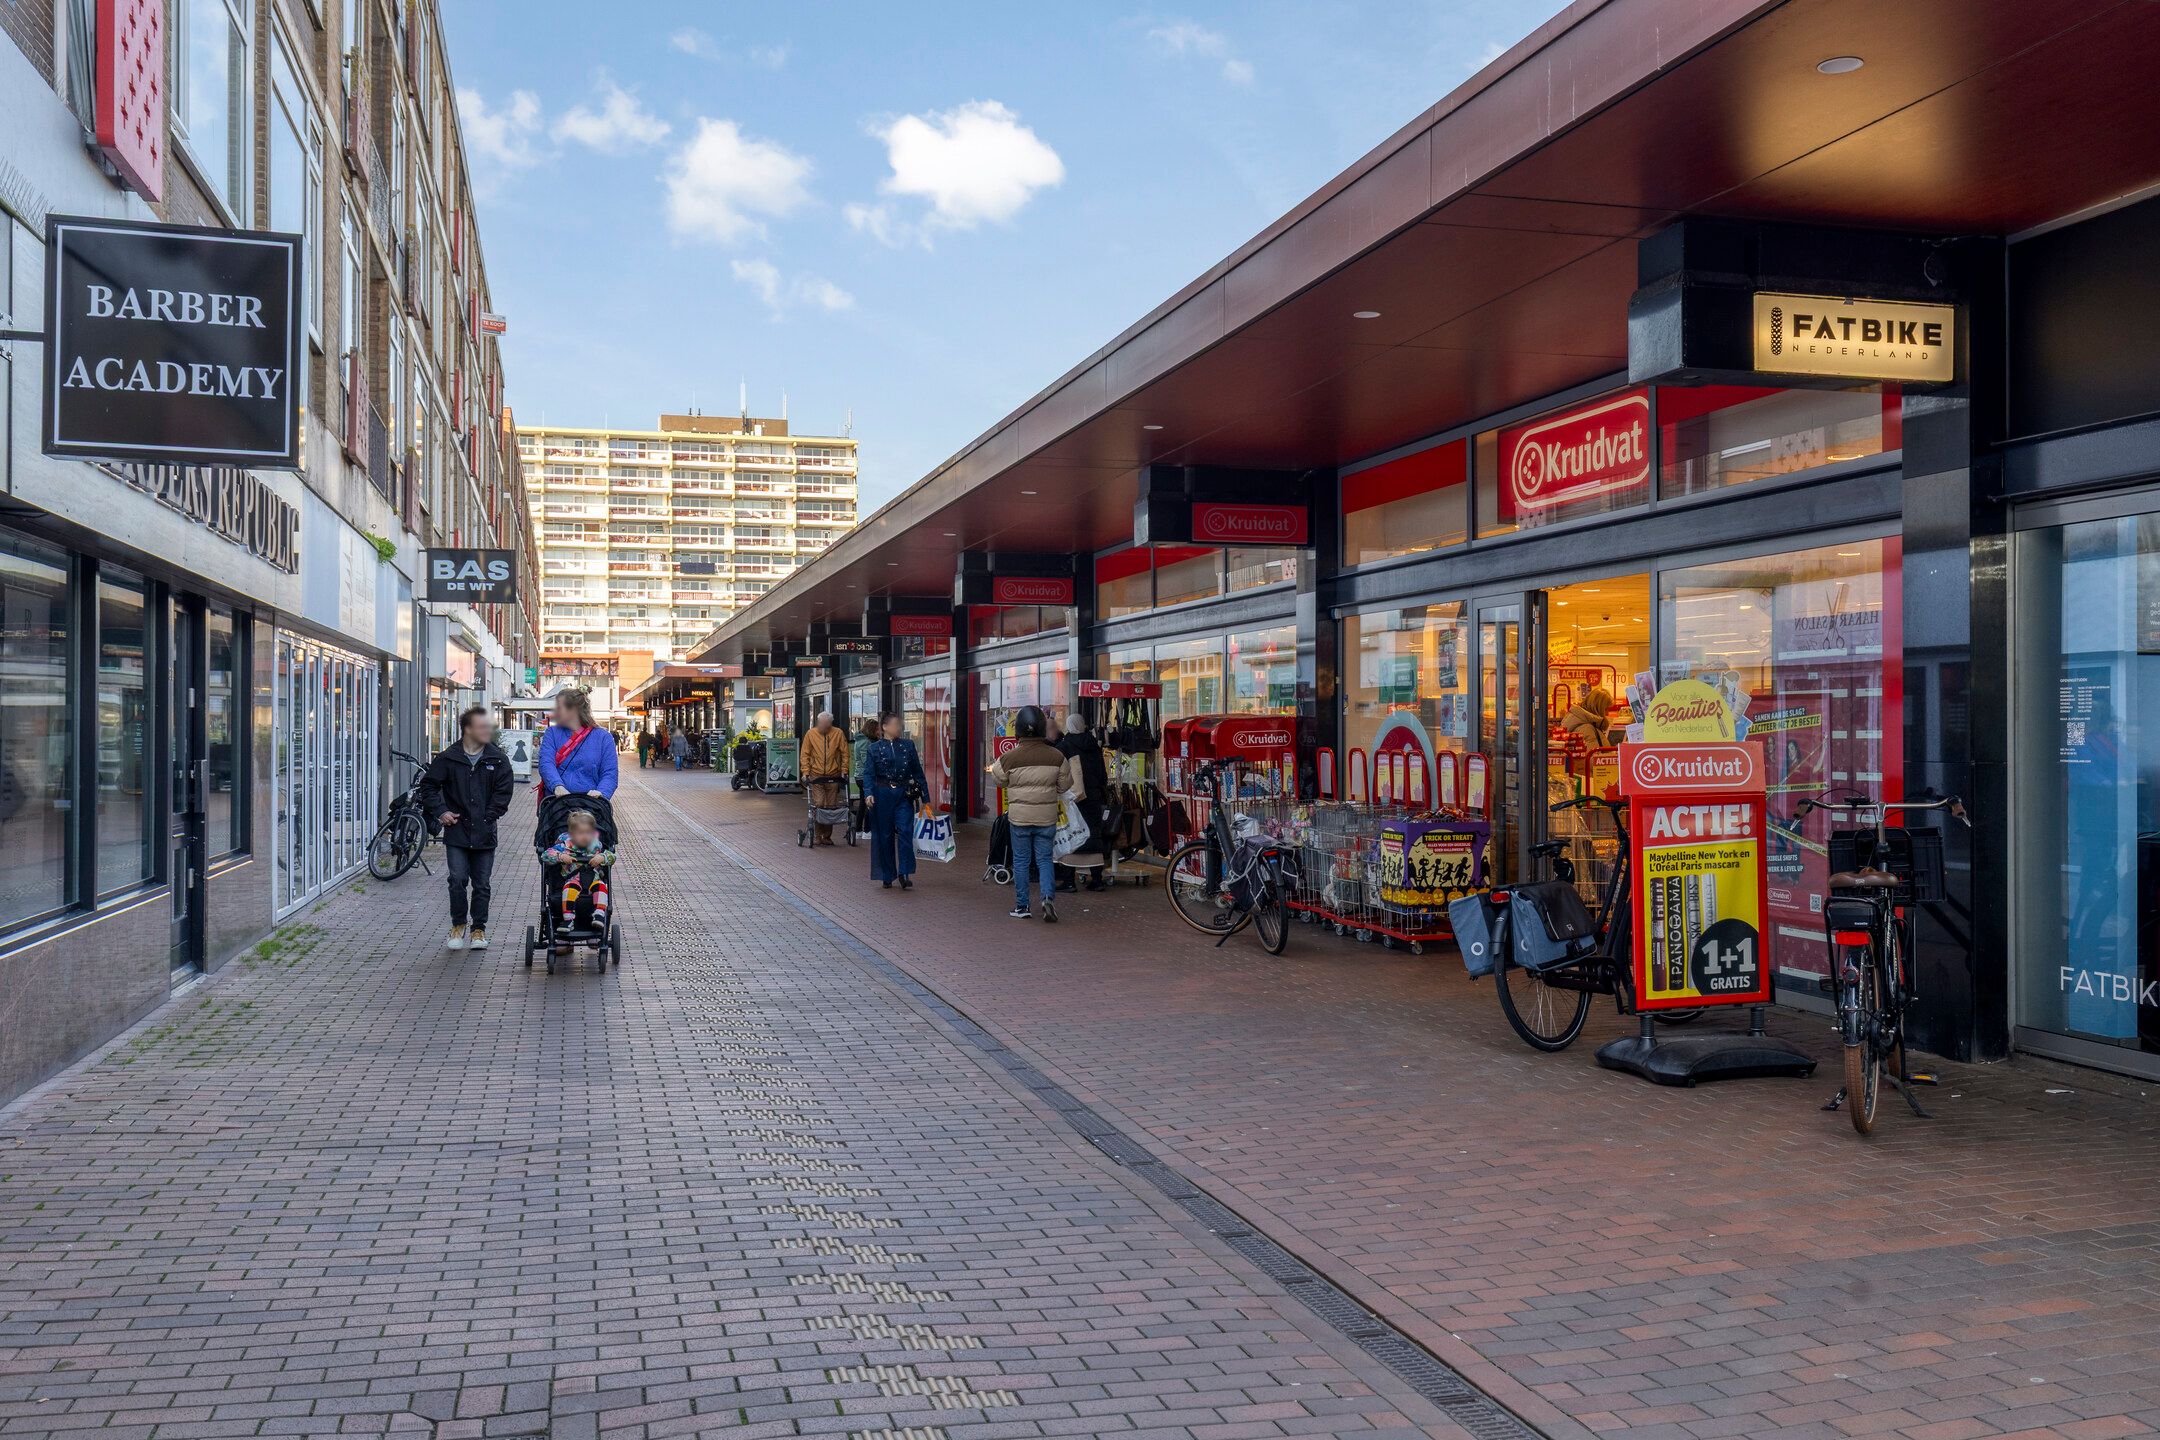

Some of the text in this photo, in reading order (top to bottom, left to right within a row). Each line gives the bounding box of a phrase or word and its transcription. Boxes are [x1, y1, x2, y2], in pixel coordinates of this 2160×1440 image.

[87, 285, 266, 328] BARBER
[1793, 314, 1942, 347] FATBIKE
[1792, 345, 1928, 360] NEDERLAND
[63, 356, 284, 399] ACADEMY
[1546, 420, 1643, 483] Kruidvat
[218, 468, 299, 575] REPUBLIC
[1228, 515, 1289, 531] Kruidvat
[433, 559, 510, 581] BAS
[447, 582, 495, 591] DE WIT
[1017, 585, 1061, 596] Kruidvat
[909, 621, 943, 630] Kruidvat
[1561, 670, 1587, 679] ACTIE!
[1606, 674, 1627, 684] FOTO
[1671, 692, 1688, 701] Voor
[1651, 699, 1724, 727] Beauties
[1754, 712, 1771, 722] SAMEN
[1789, 707, 1806, 717] SLAG?
[1799, 715, 1820, 726] BESTIE
[1677, 724, 1713, 734] Nederland
[1248, 733, 1288, 744] Kruidvat
[1664, 756, 1743, 778] Kruidvat
[1649, 803, 1751, 839] ACTIE!
[1649, 849, 1750, 863] Maybelline New York en
[1649, 860, 1740, 872] L'Oréal Paris mascara
[1701, 937, 1756, 975] 1+1
[1710, 975, 1751, 990] GRATIS
[2060, 966, 2158, 1007] FATBIK
